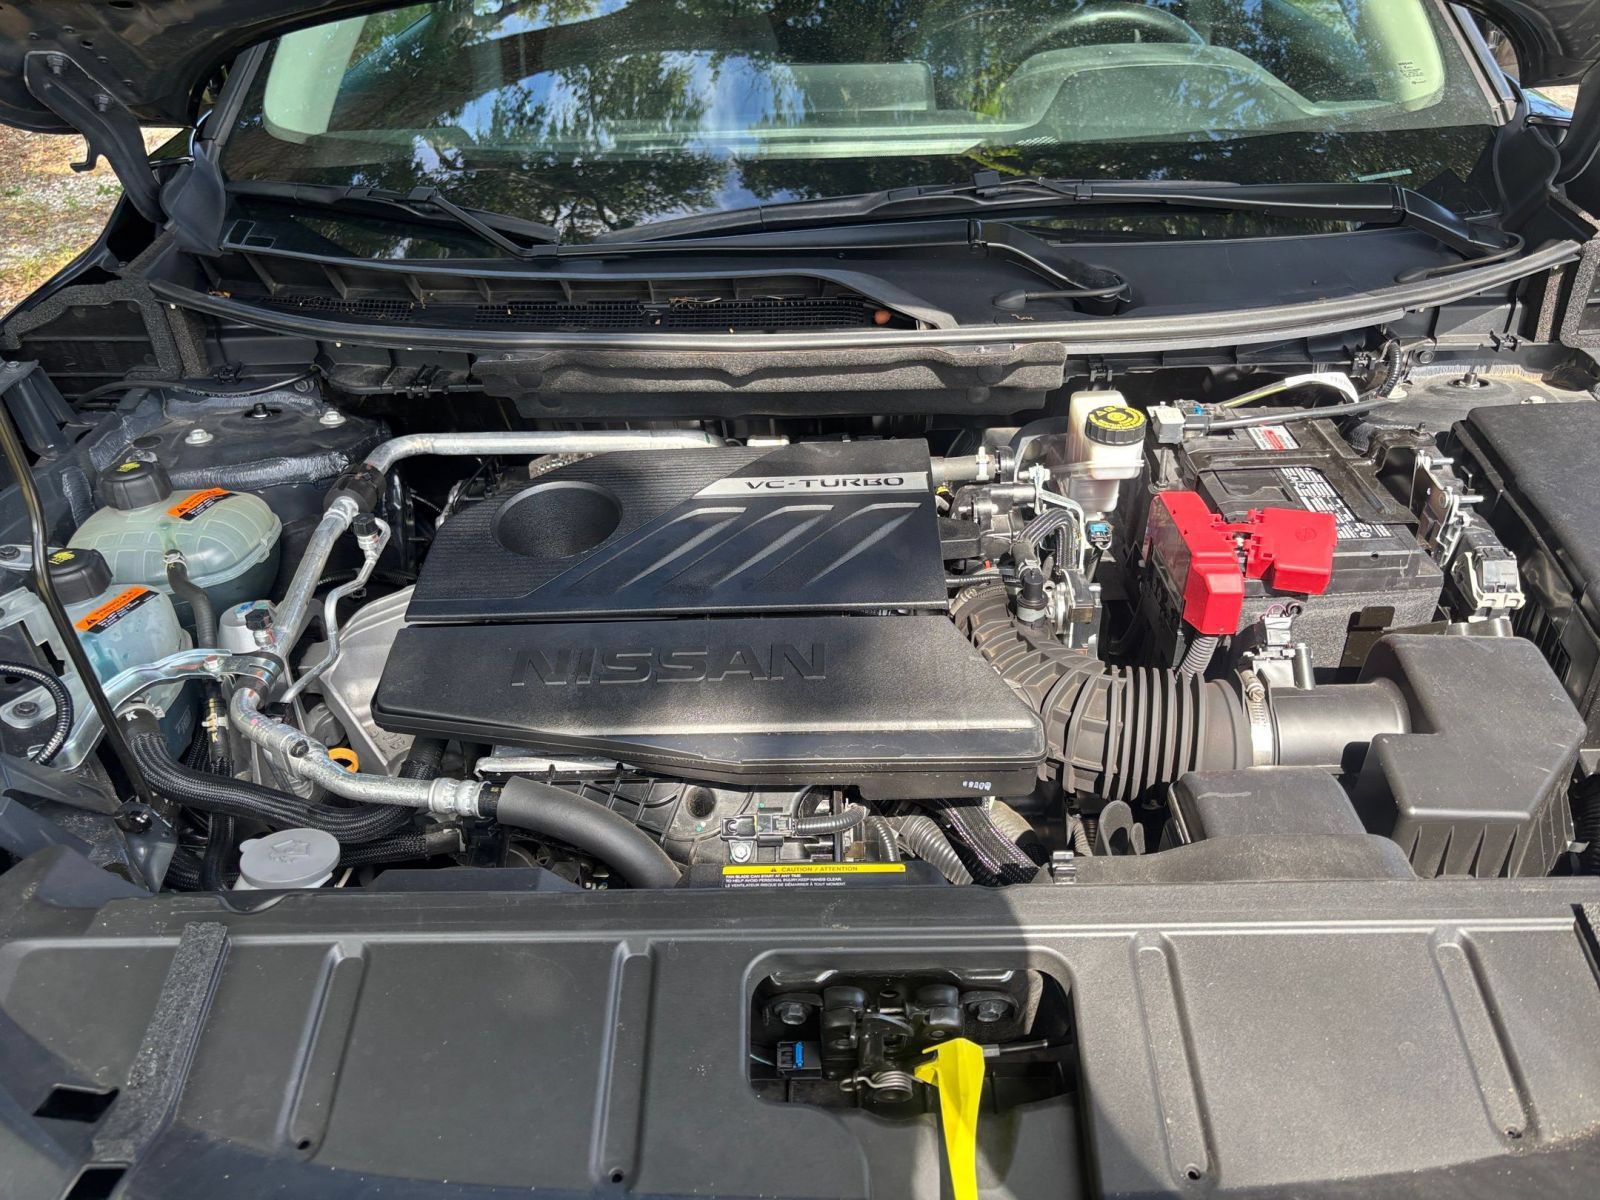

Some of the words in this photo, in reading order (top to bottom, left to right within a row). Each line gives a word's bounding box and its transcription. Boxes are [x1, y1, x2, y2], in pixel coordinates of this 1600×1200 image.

[744, 477, 904, 489] VC-TURBO
[511, 643, 826, 686] NISSAN
[125, 710, 138, 721] K
